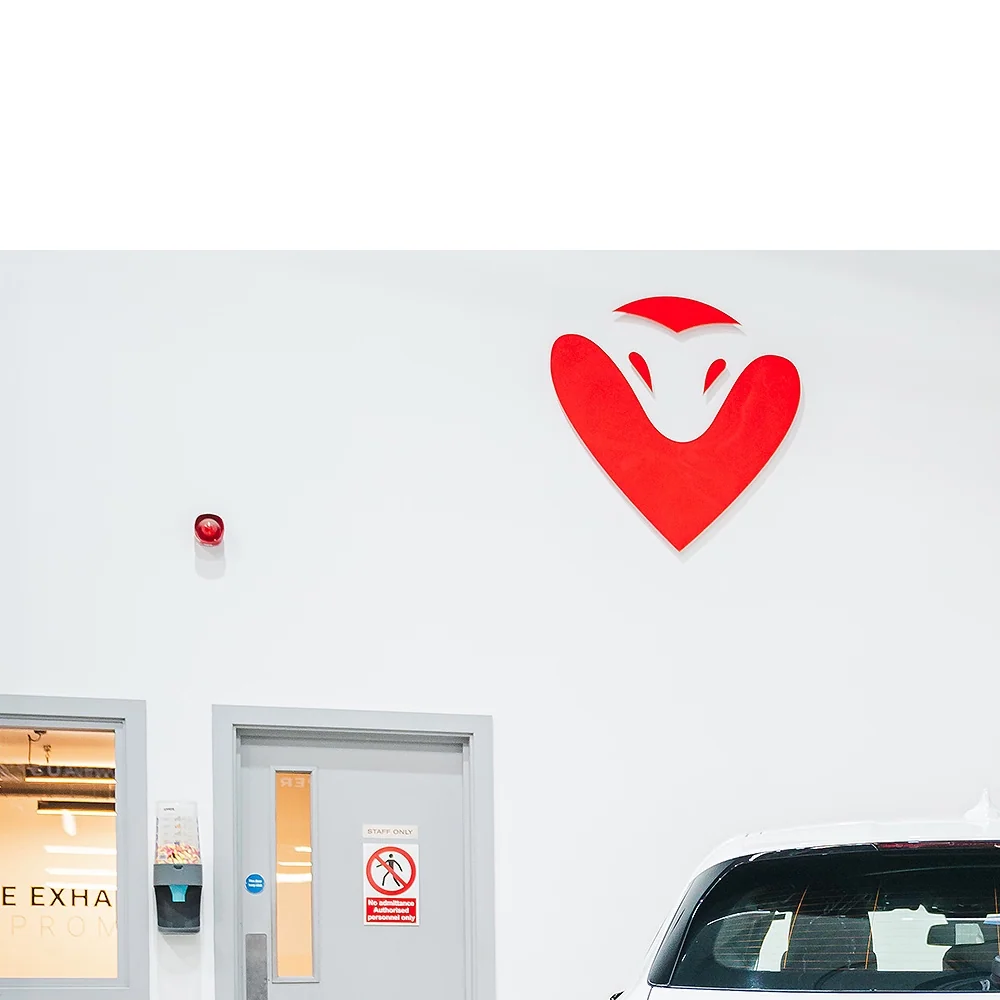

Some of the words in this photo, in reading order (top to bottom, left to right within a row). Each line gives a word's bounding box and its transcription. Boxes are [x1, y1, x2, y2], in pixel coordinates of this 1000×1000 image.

[2, 886, 16, 906] E
[31, 886, 112, 907] EXHA
[367, 899, 378, 907] No
[379, 899, 415, 907] admittance
[367, 914, 400, 922] personnel
[401, 914, 416, 923] only
